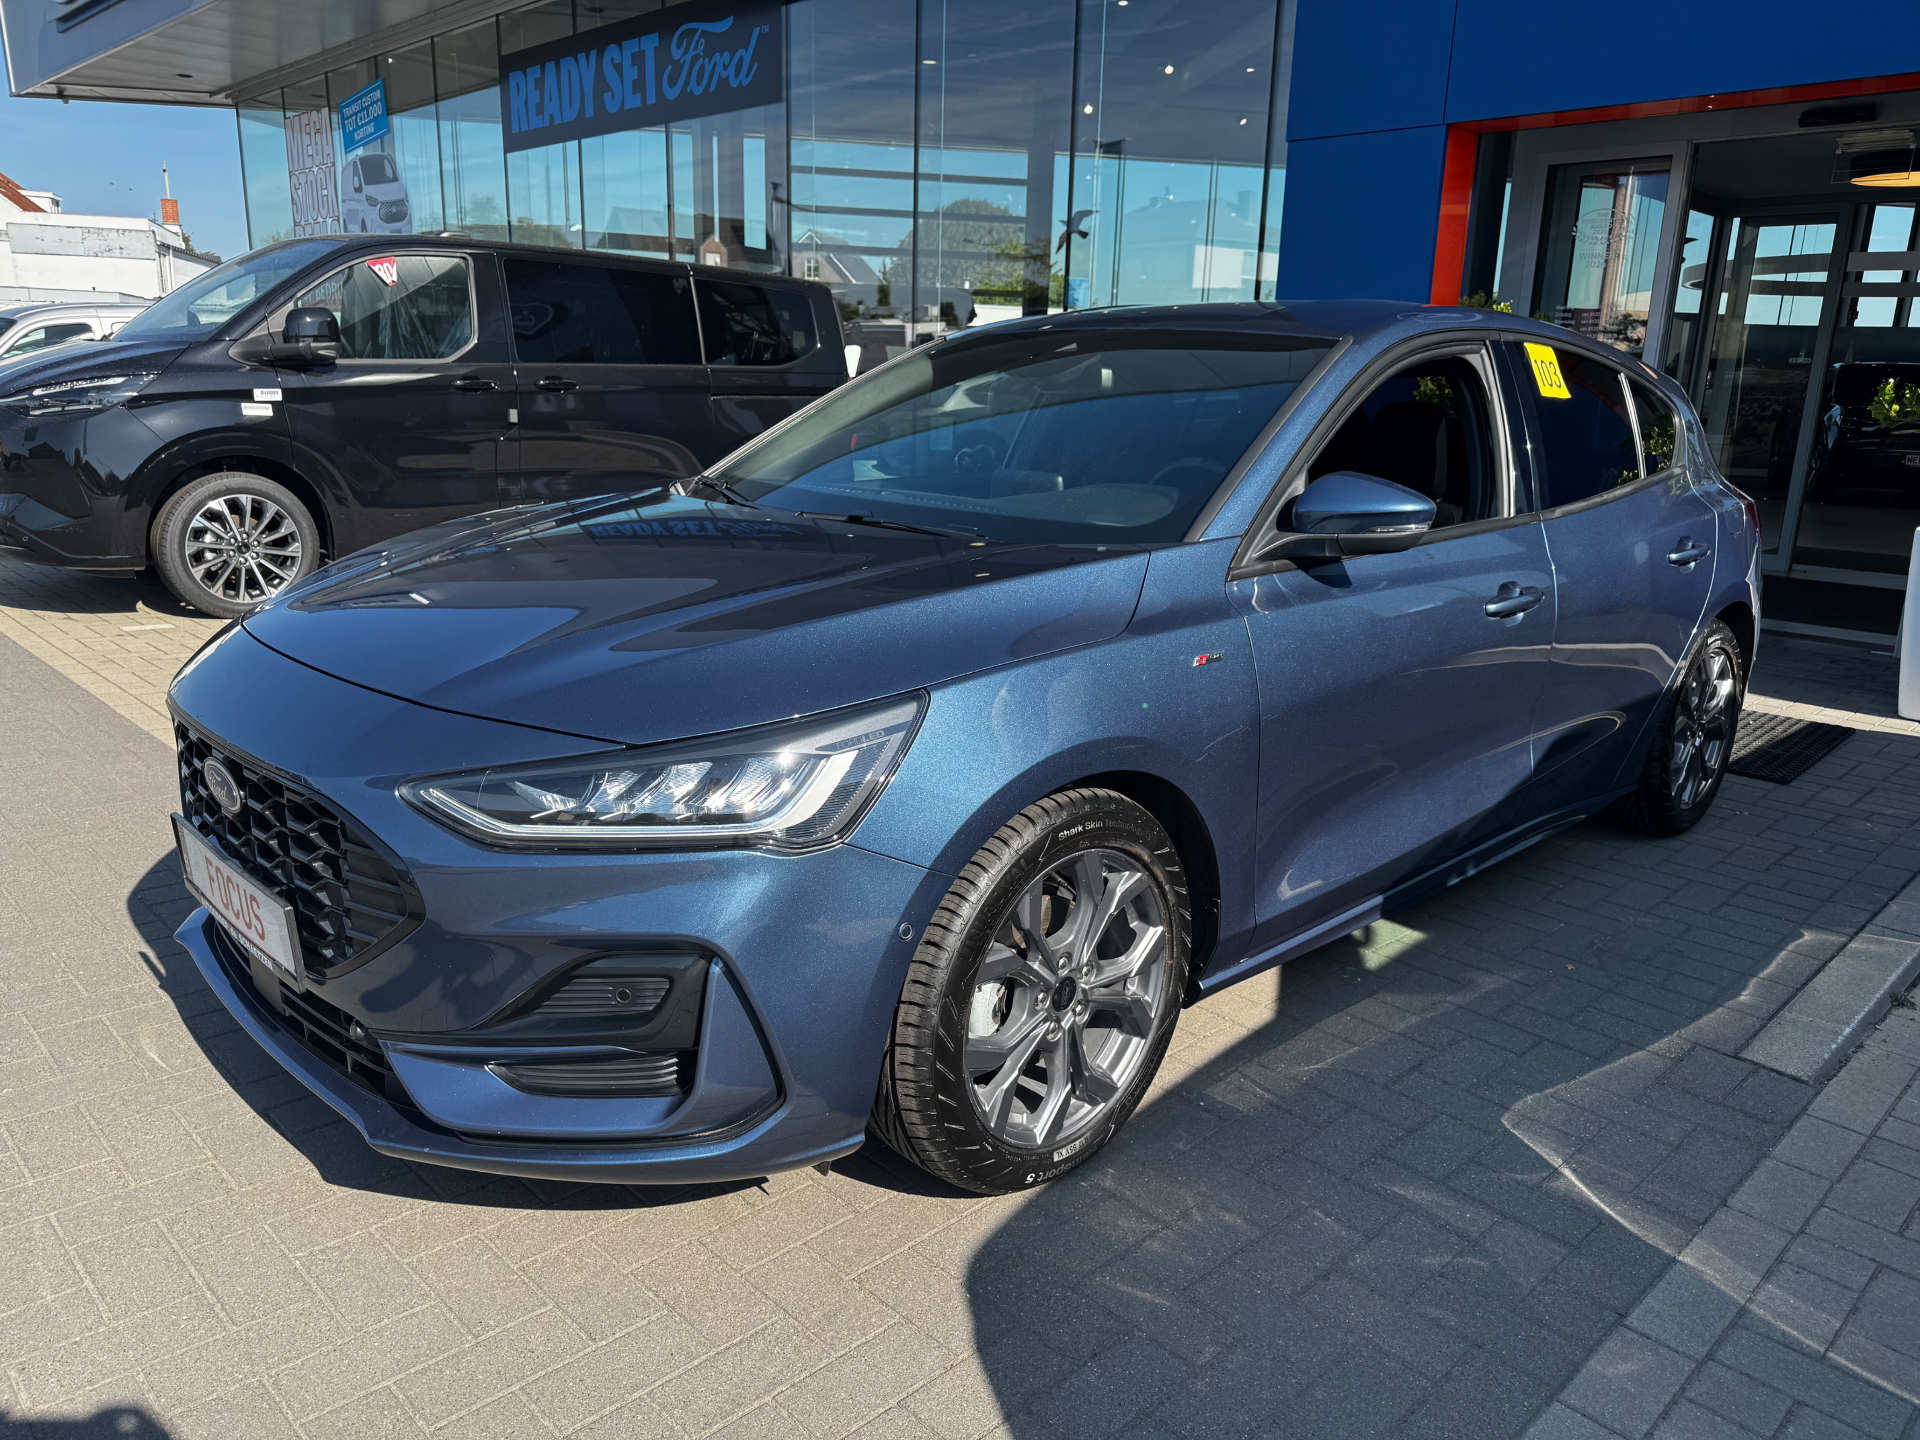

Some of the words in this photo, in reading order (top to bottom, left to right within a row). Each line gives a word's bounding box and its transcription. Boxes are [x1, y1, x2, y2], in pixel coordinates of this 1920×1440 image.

[508, 49, 597, 134] READY
[602, 32, 660, 114] SET
[662, 15, 761, 101] Ford
[343, 99, 361, 119] TRANSIT
[362, 88, 381, 108] CUSTOM
[344, 115, 357, 133] TOT
[357, 101, 383, 126] €11.000
[285, 106, 335, 173] MEGA
[289, 164, 340, 224] STOCK
[1584, 260, 1606, 268] 2024
[1534, 358, 1563, 389] 103
[1058, 824, 1084, 841] Shark
[1084, 819, 1103, 830] Skin
[1104, 819, 1145, 837] Technology
[204, 855, 266, 941] FOCUS
[1025, 1173, 1036, 1184] 5
